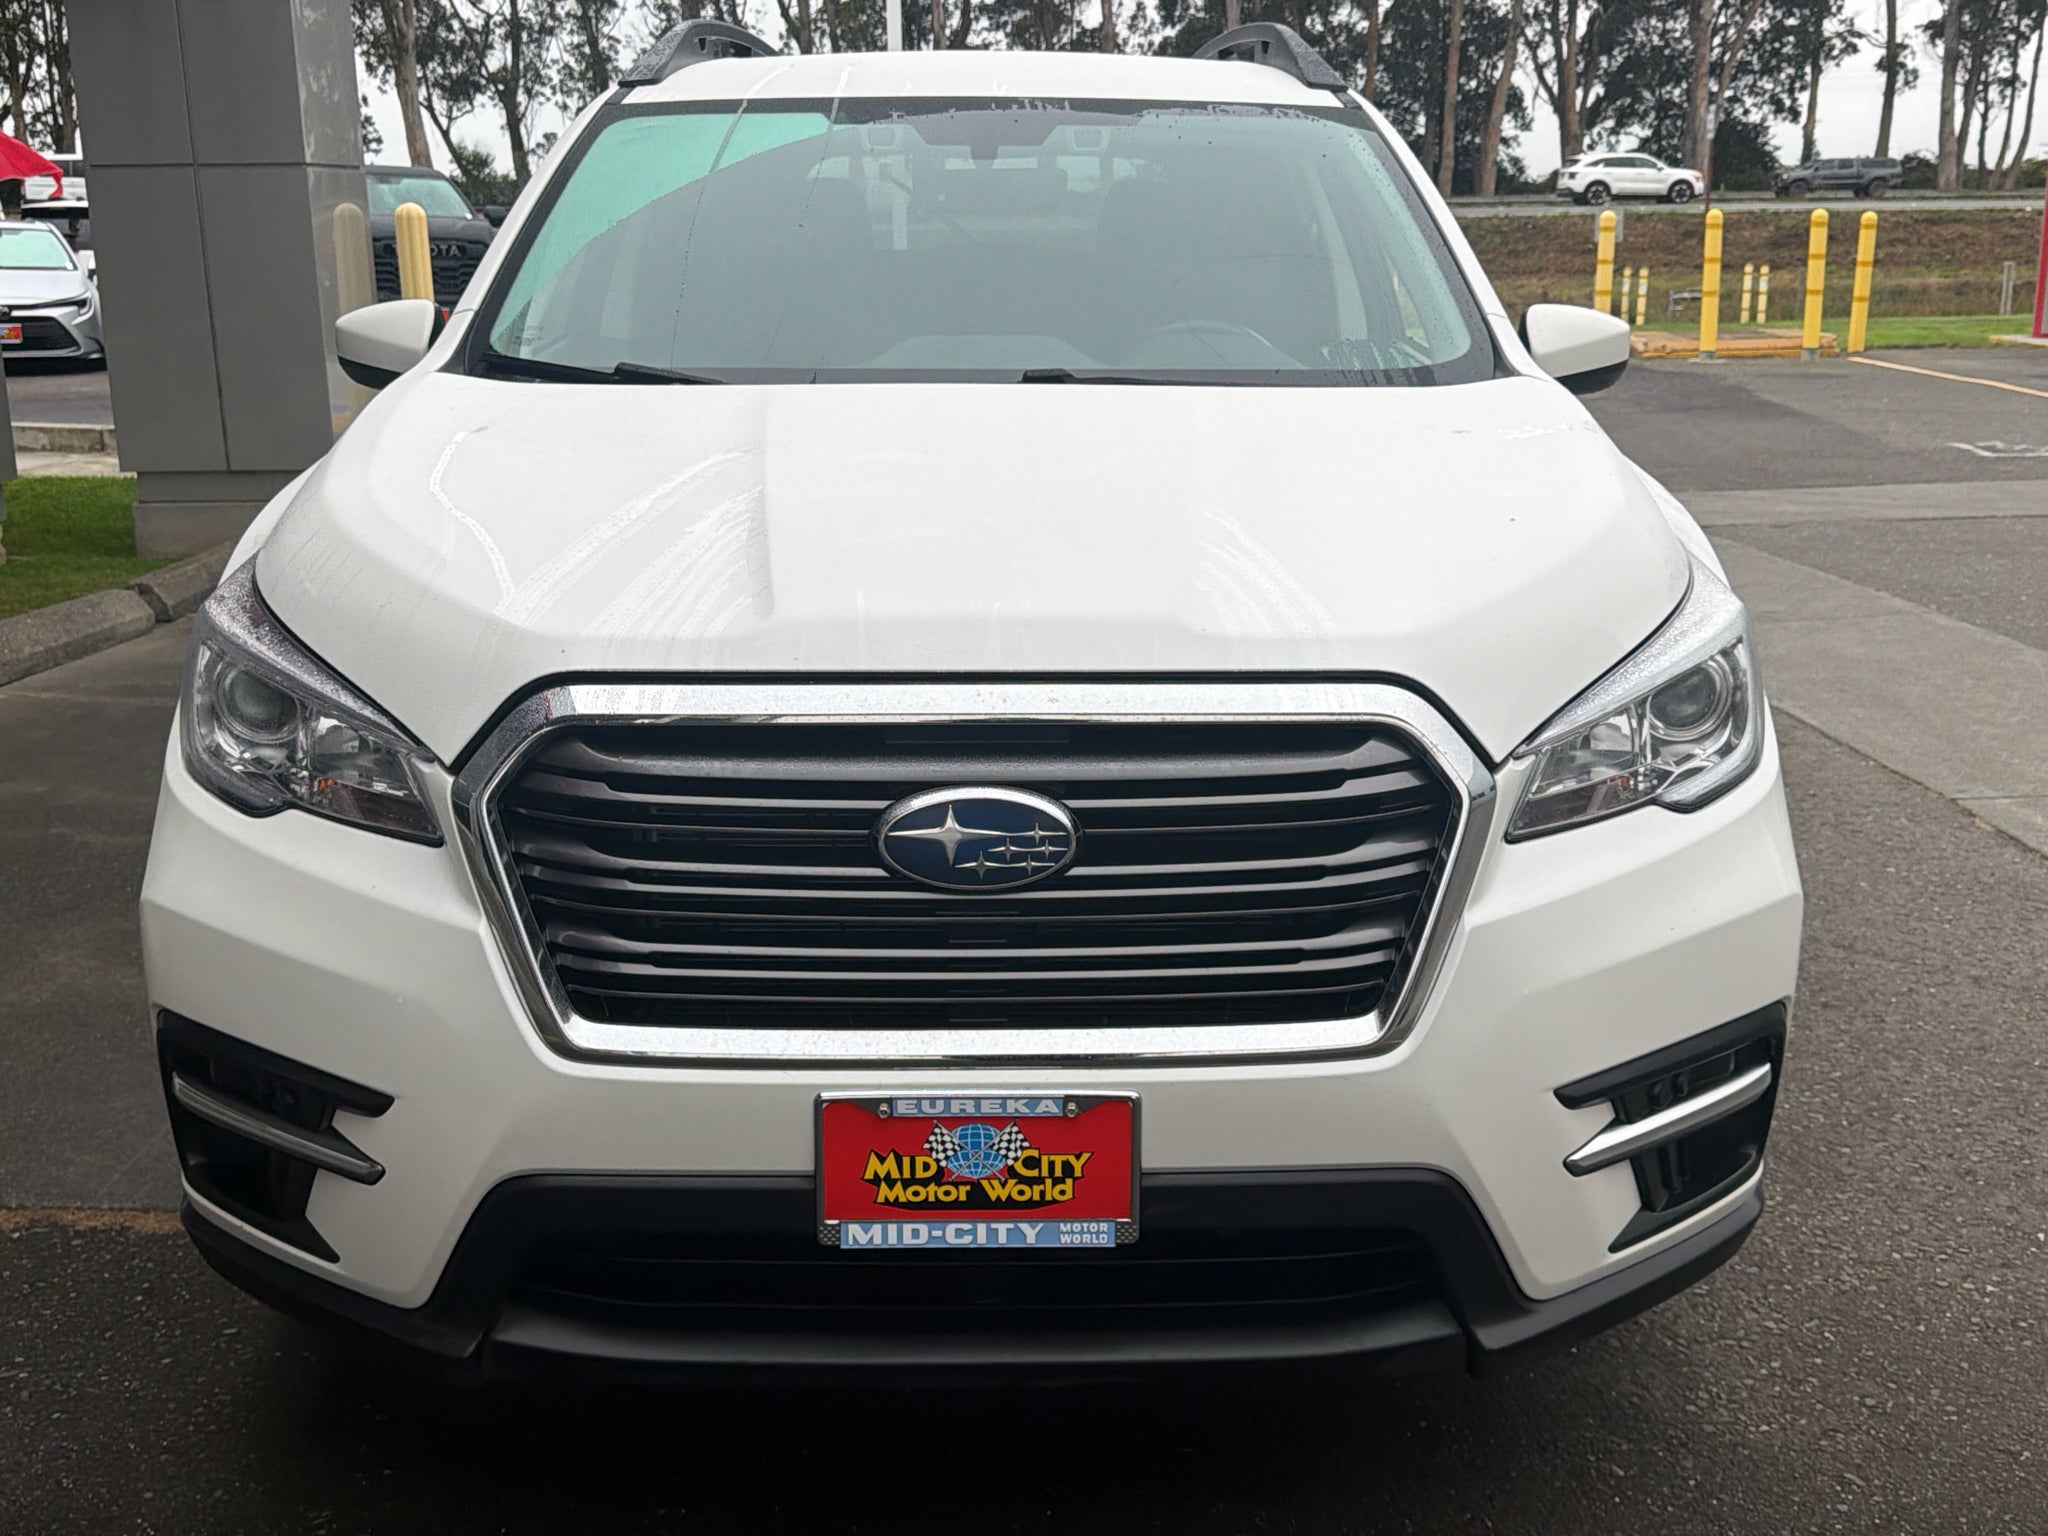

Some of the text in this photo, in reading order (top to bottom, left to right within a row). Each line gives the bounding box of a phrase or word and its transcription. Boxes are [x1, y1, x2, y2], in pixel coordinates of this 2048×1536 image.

[896, 1099, 1060, 1114] EUREKA
[864, 1149, 1093, 1180] MID CITY
[876, 1178, 1075, 1203] Motor World
[847, 1222, 1045, 1246] MID-CITY
[1059, 1222, 1109, 1233] MOTOR
[1059, 1233, 1109, 1244] WORLD
